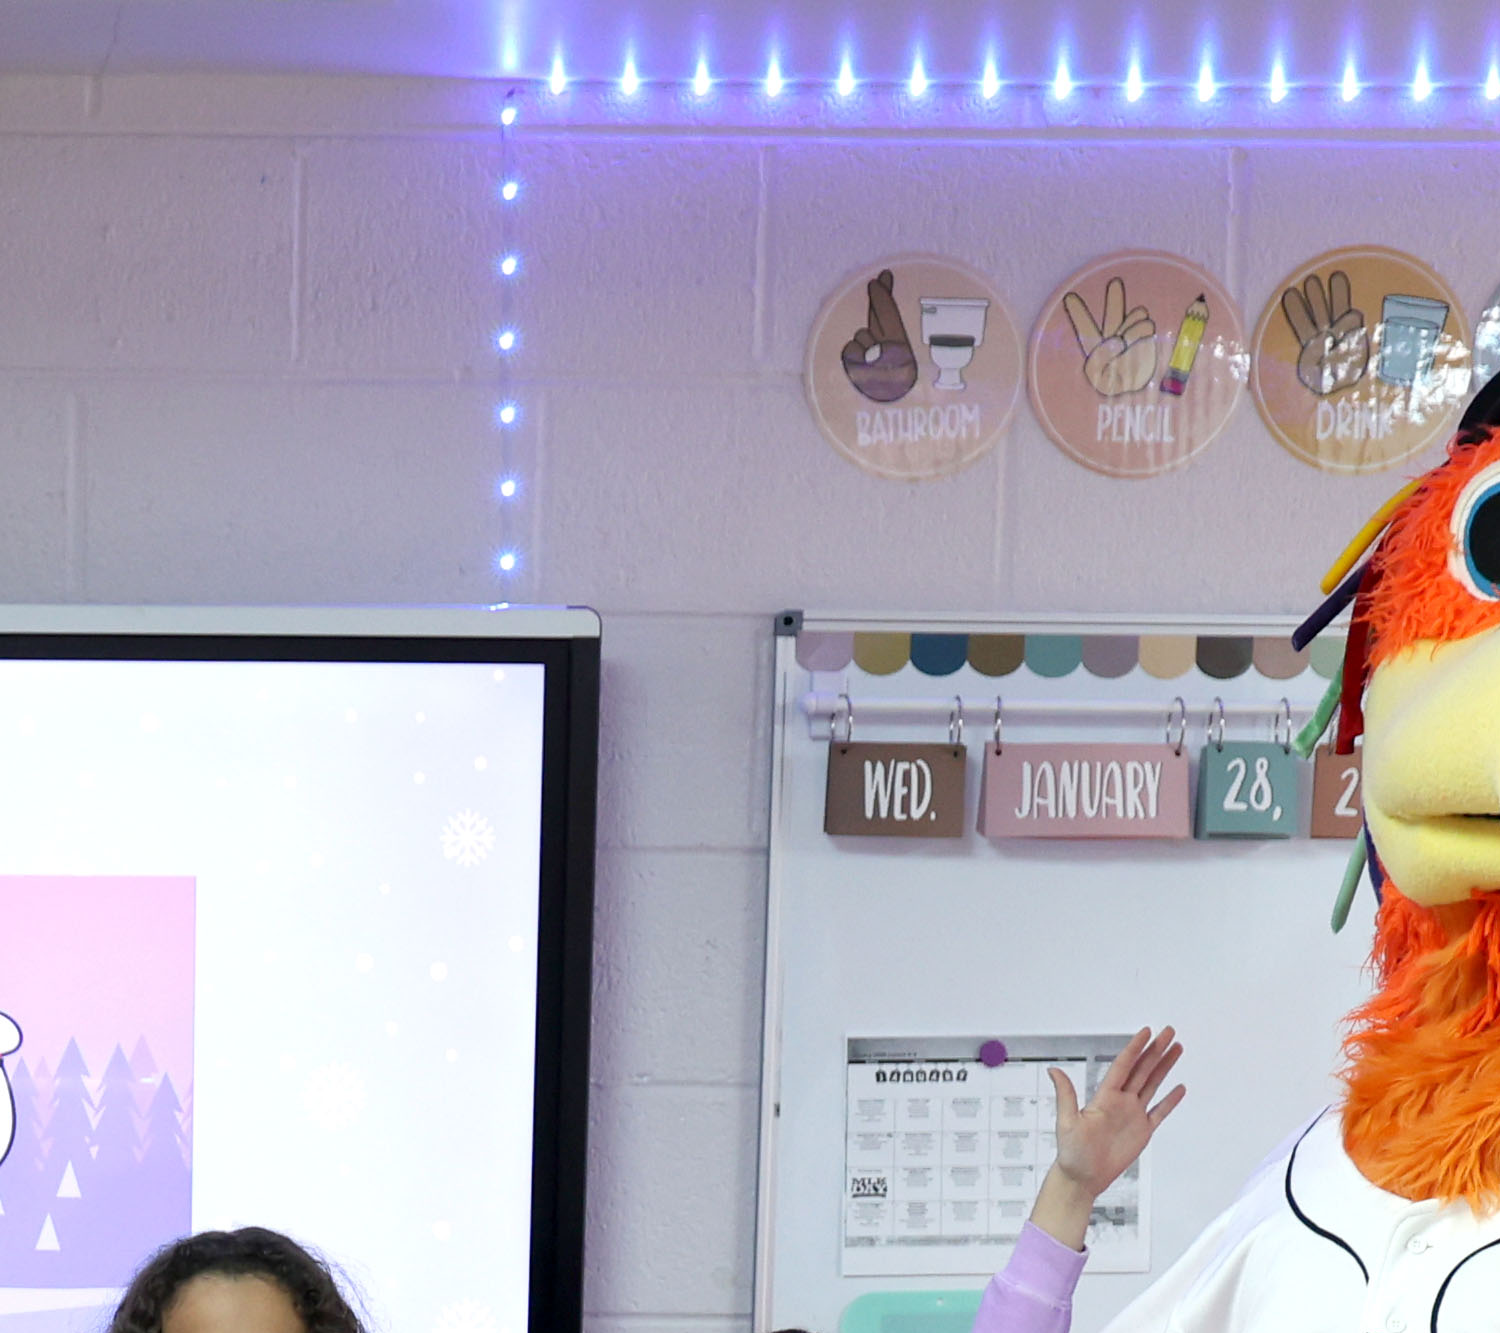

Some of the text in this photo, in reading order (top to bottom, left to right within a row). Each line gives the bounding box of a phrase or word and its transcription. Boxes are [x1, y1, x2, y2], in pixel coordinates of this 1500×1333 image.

[855, 403, 983, 449] BATHROOM
[1096, 404, 1175, 444] PENCIL
[863, 759, 937, 822] WED.
[1014, 760, 1162, 820] JANUARY
[1222, 757, 1282, 822] 28,
